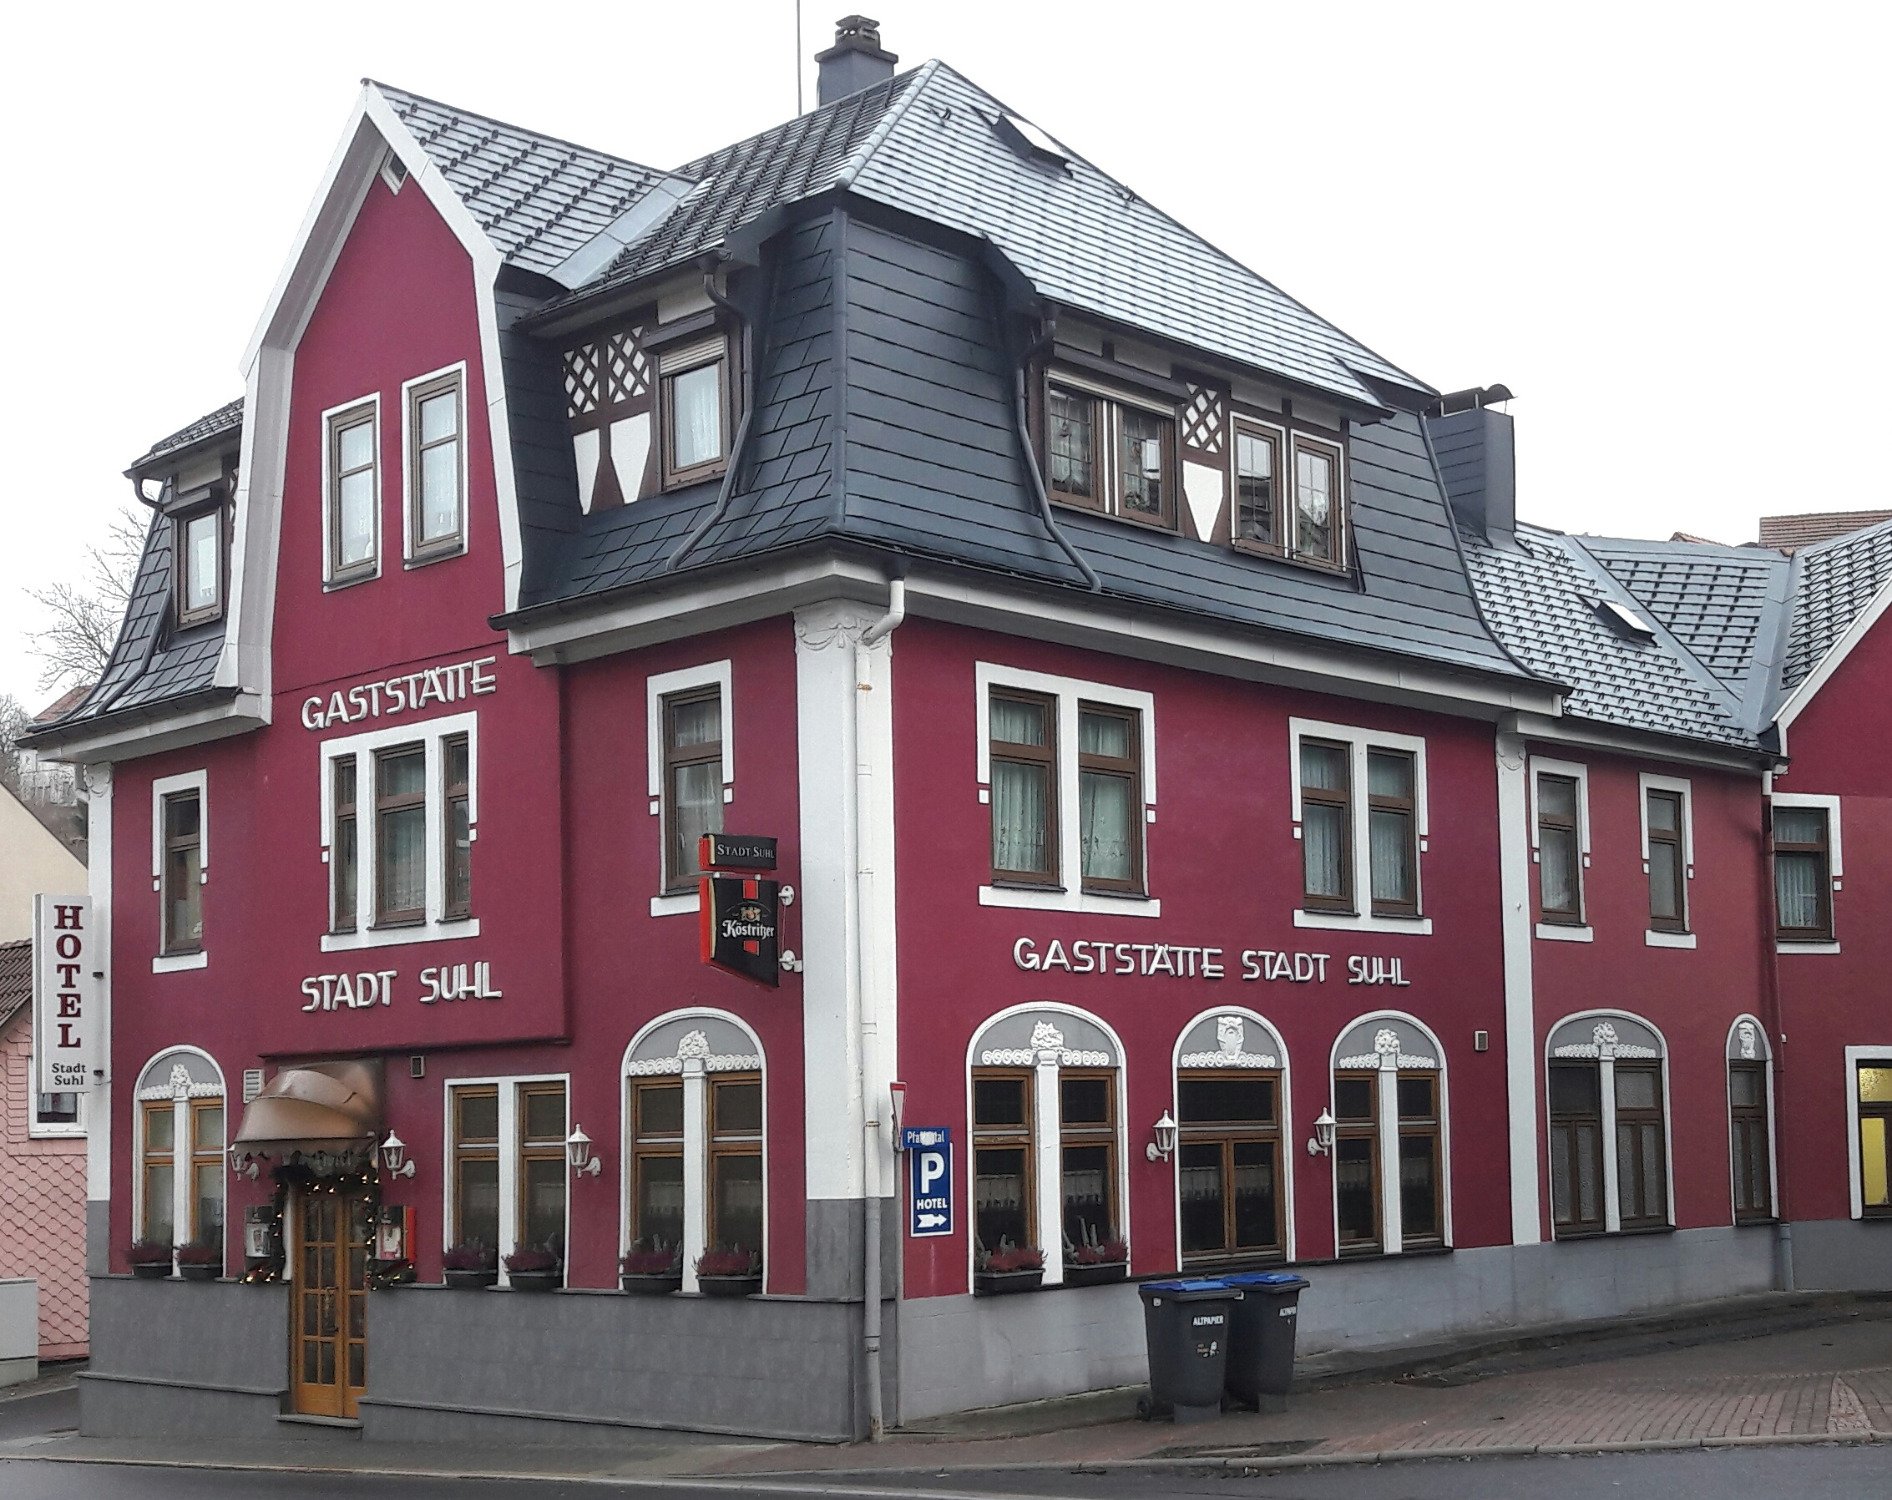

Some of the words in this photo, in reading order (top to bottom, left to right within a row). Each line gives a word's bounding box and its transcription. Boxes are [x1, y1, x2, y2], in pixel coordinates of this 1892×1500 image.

[301, 656, 496, 732] GASTSTÄTTE
[717, 844, 751, 857] STADT
[722, 919, 775, 940] Köstritzer
[54, 905, 84, 1049] HOTEL
[1012, 937, 1225, 979] GASTSTÄTTE
[1241, 950, 1331, 983] STADT
[1347, 955, 1412, 987] SUHL
[301, 970, 398, 1013] STADT
[419, 961, 503, 1004] SUHL
[51, 1062, 87, 1074] Stadt
[54, 1074, 84, 1086] Suhl
[921, 1152, 945, 1194] P
[917, 1198, 947, 1210] HOTEL
